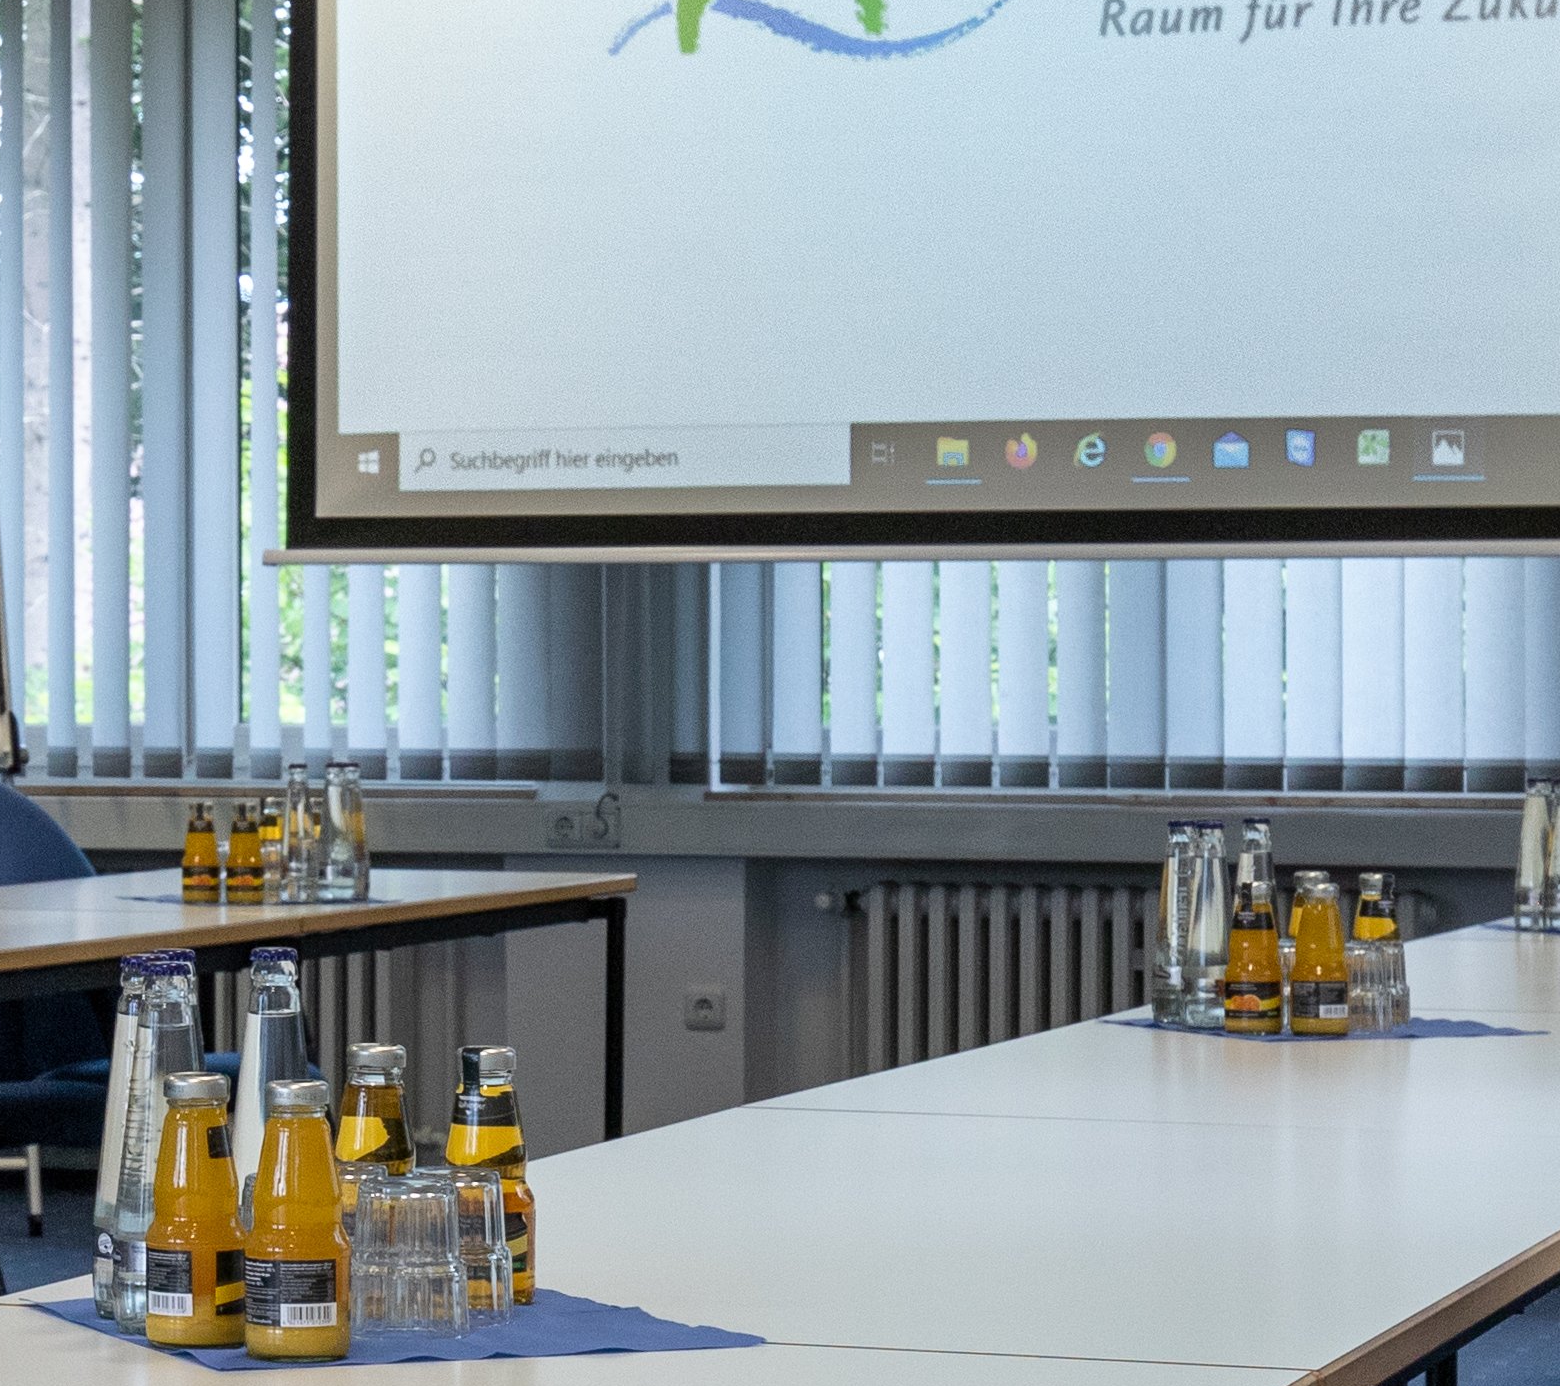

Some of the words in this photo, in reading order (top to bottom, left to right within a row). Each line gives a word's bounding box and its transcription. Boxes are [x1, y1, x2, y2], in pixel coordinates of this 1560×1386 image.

[448, 447, 552, 476] Suchbegriff
[555, 448, 590, 469] hier
[594, 448, 679, 476] eingeben
